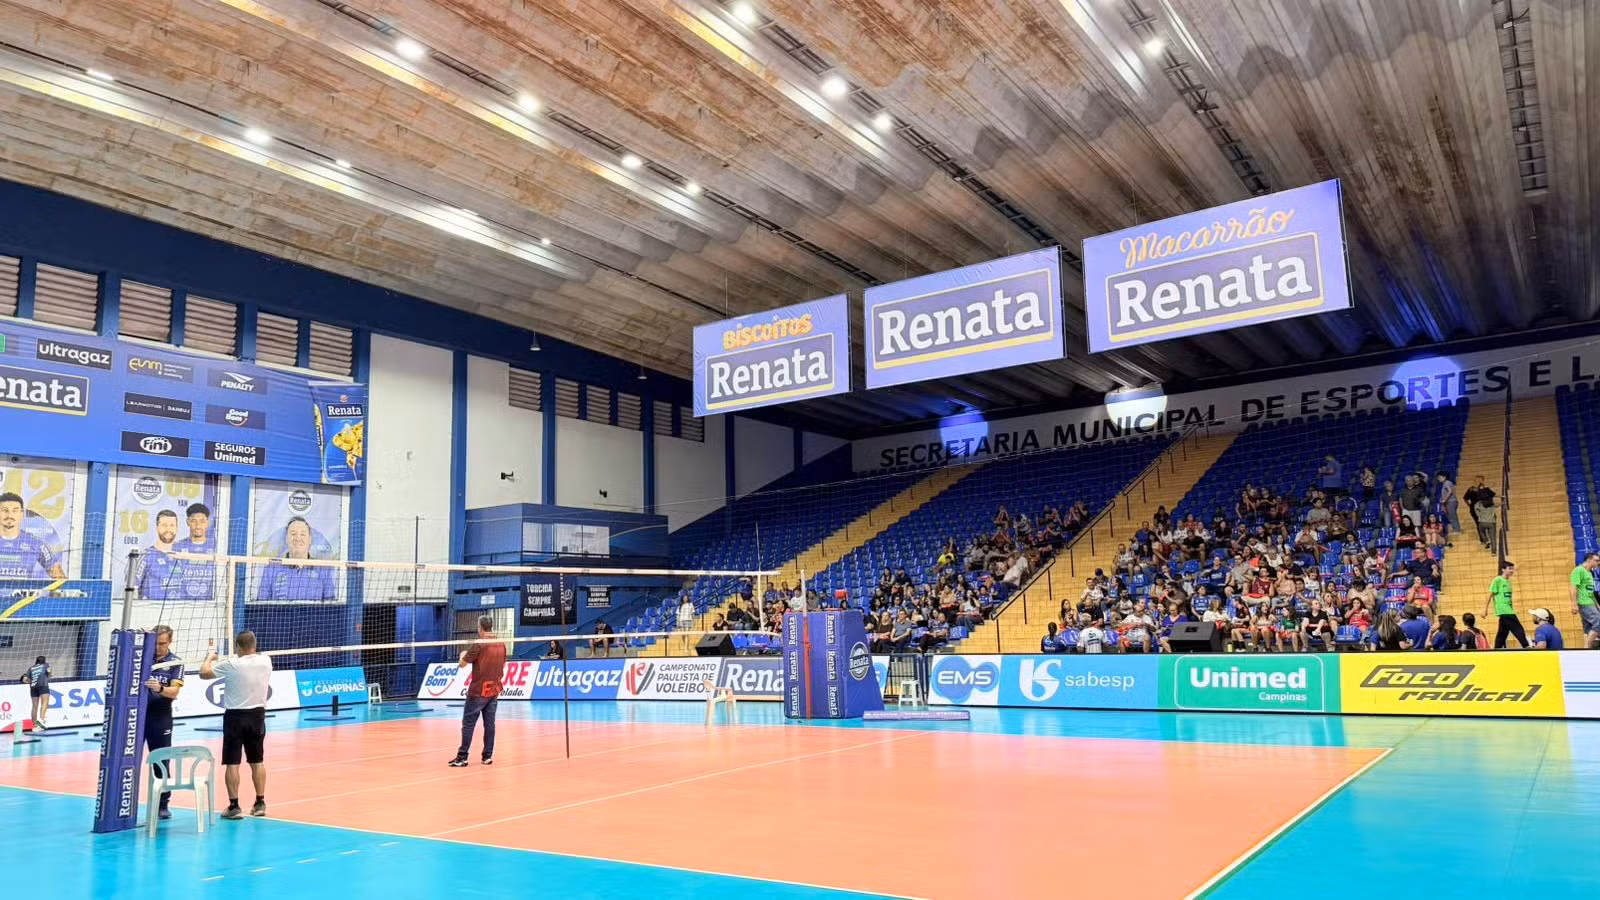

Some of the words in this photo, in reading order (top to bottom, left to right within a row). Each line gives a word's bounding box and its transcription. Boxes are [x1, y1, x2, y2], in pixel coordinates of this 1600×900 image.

[1119, 206, 1295, 270] Macarrão
[1113, 254, 1313, 328] Renata
[878, 288, 1045, 355] Renata
[39, 342, 111, 364] ultragaz
[709, 347, 828, 398] Renata
[221, 380, 254, 391] PENALTY
[225, 413, 242, 421] Bom
[229, 409, 248, 418] Good
[327, 405, 362, 416] Renata
[880, 428, 1040, 468] SECRETARIA
[1053, 404, 1225, 446] MUNICIPAL
[1241, 395, 1285, 423] DE
[1300, 365, 1510, 414] ESPORTES
[1529, 360, 1551, 387] E
[1571, 355, 1600, 382] L
[214, 451, 256, 464] Unimed
[215, 442, 256, 454] SEGUROS
[135, 484, 161, 494] Renata
[528, 596, 552, 605] SEMPRE
[788, 616, 797, 645] Renata
[827, 614, 835, 644] Renata
[105, 648, 116, 695] Renata
[130, 649, 143, 696] Renata
[433, 664, 460, 676] Good
[659, 663, 717, 671] CAMPEONATO
[790, 651, 798, 680] Renata
[828, 650, 836, 680] Renata
[849, 656, 869, 669] Renata
[425, 675, 448, 687] Bom
[534, 665, 623, 694] ultragaz
[657, 672, 700, 681] PAULISTA
[702, 672, 715, 681] DE
[726, 663, 784, 692] Rena
[937, 670, 992, 685] EMS
[1064, 670, 1136, 691] sabesp
[1190, 666, 1307, 689] Unimed
[1368, 667, 1461, 686] Foco
[314, 682, 366, 694] CAMPINAS
[656, 682, 711, 693] VOLEIBO
[1258, 691, 1307, 702] Campinas
[791, 687, 799, 716] Renata
[830, 686, 839, 716] Renata
[124, 708, 138, 757] Renata
[119, 768, 134, 818] Renata
